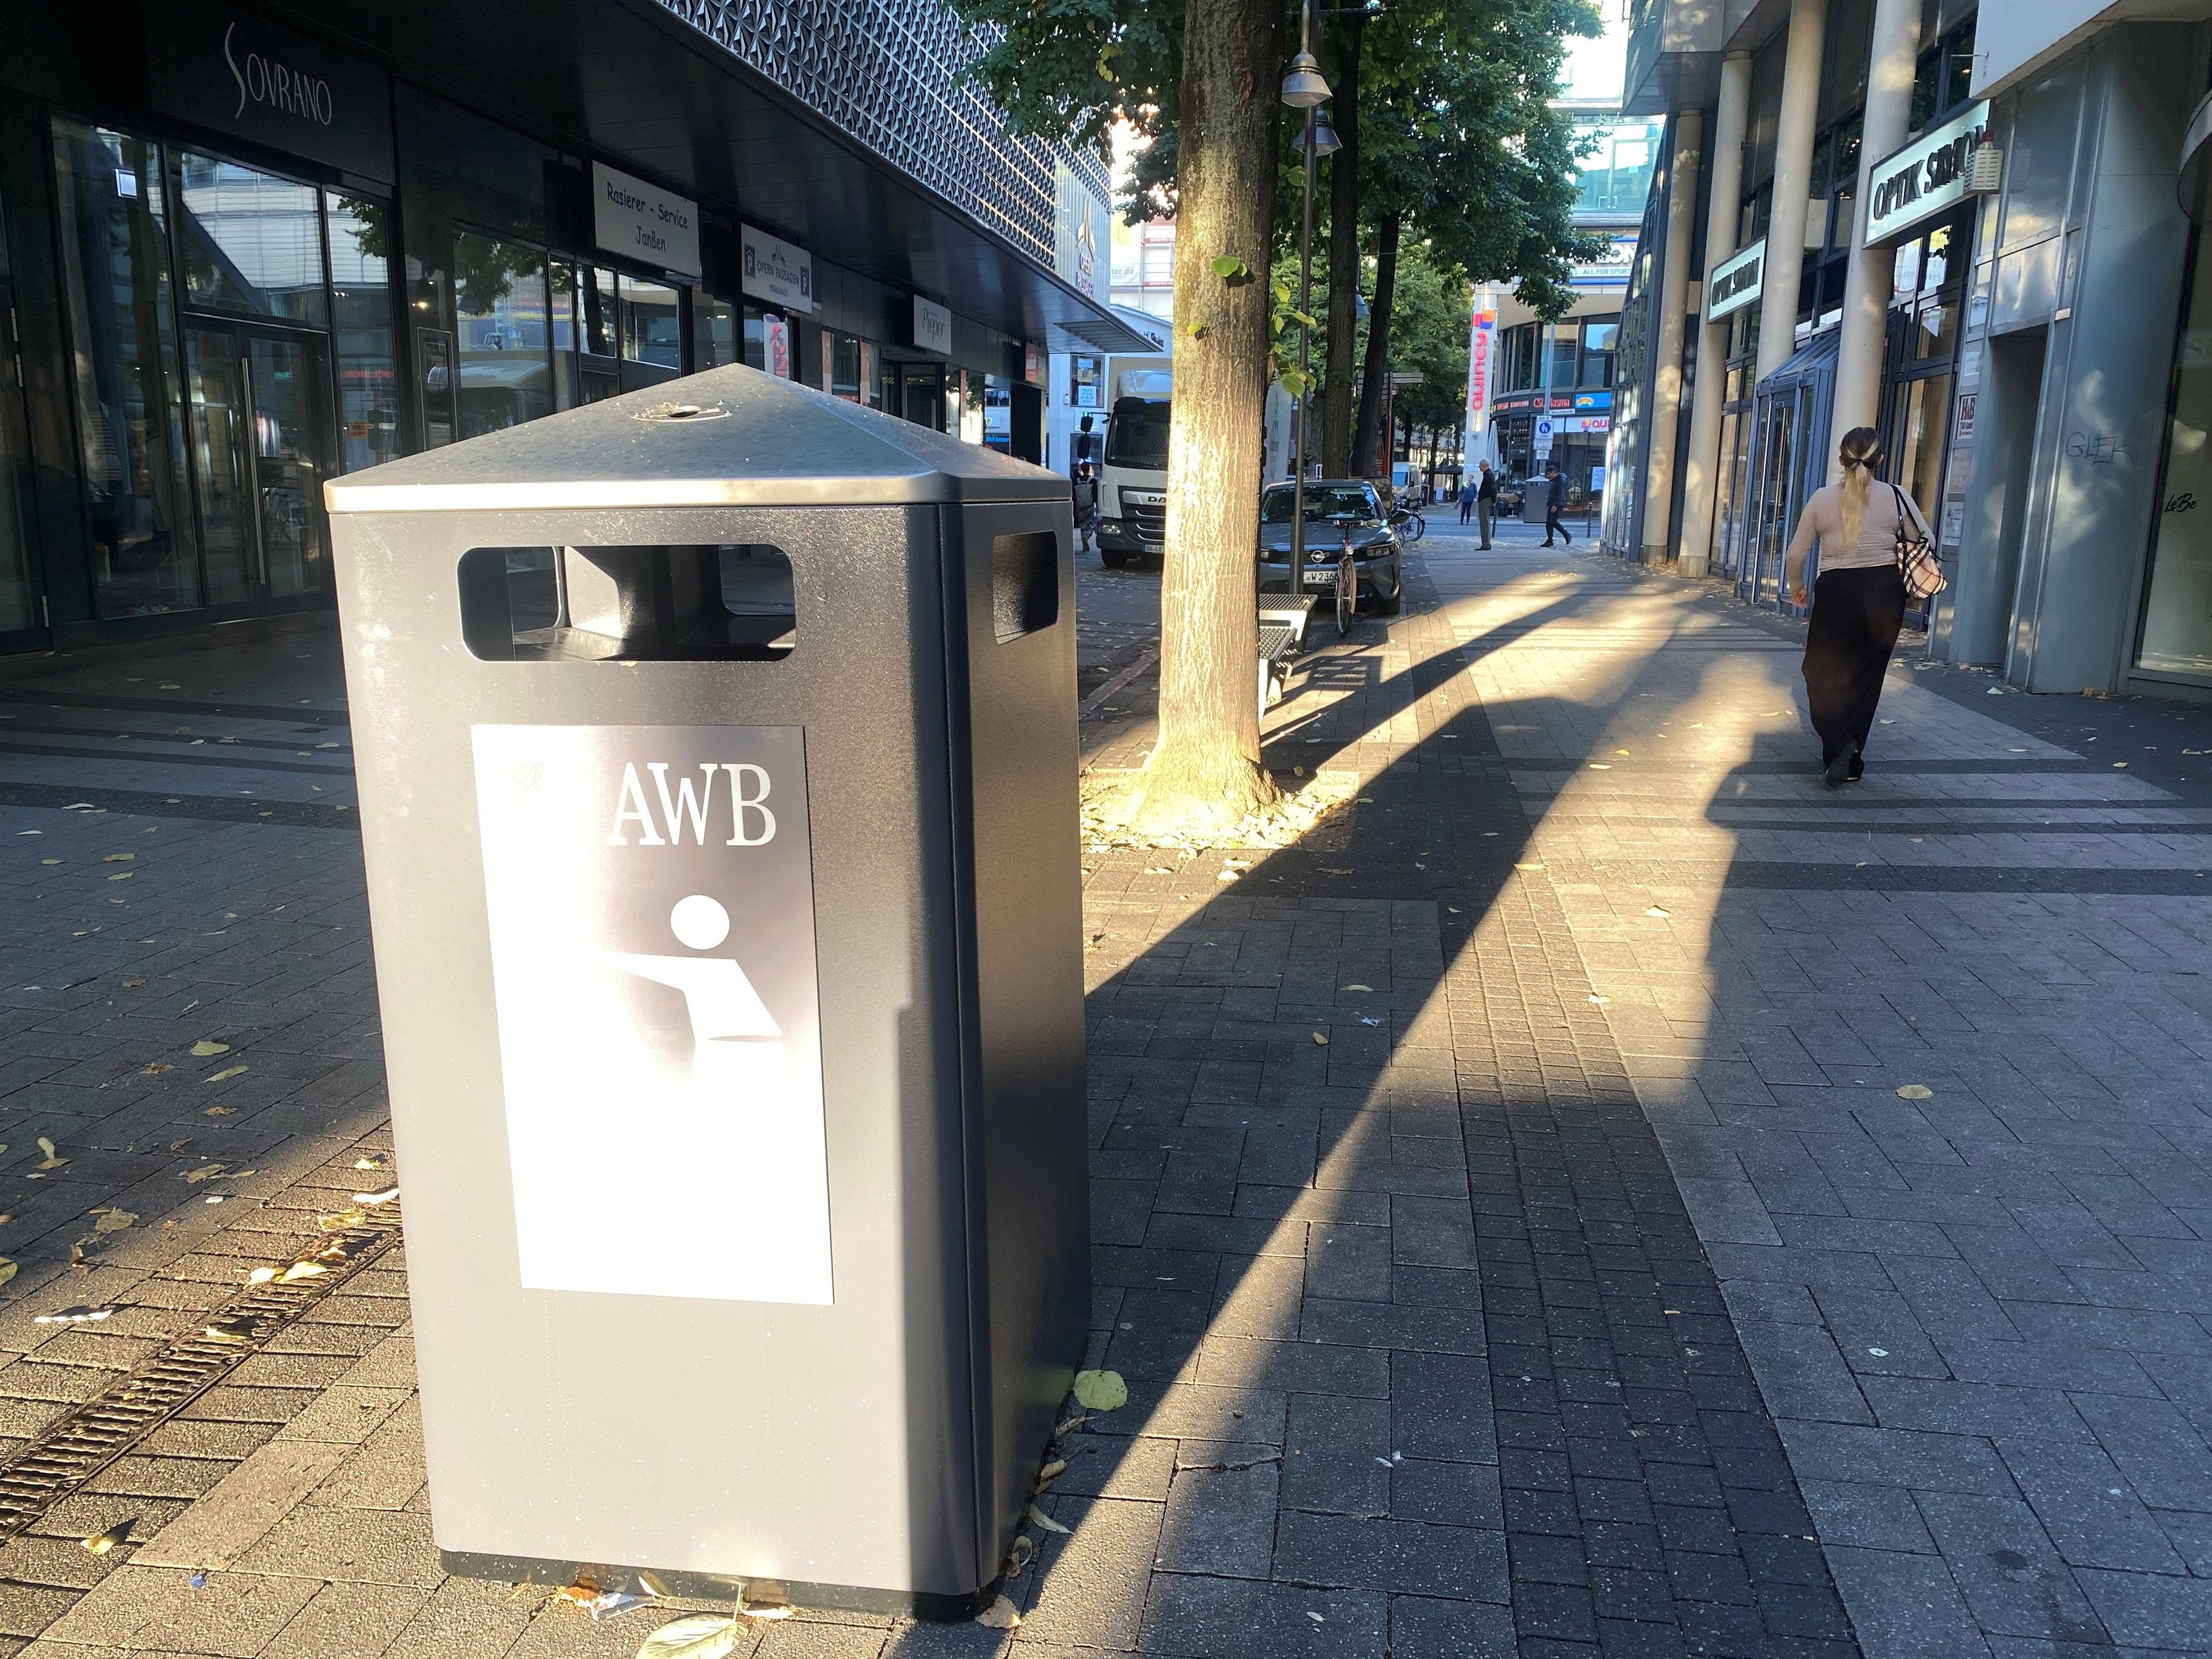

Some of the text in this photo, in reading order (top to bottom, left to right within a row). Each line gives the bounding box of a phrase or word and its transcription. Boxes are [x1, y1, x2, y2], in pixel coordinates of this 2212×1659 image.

[224, 22, 332, 126] SOVRANO
[1873, 159, 1926, 221] OPTIK
[607, 181, 645, 213] Rasierer
[658, 202, 688, 229] Service
[635, 225, 666, 253] Janßen
[757, 260, 800, 286] OPERN PASSAGEN
[769, 283, 789, 298] PARKHAUS
[922, 307, 945, 342] Pieper
[1551, 398, 1570, 408] lasma
[1592, 420, 1610, 428] QUI
[2164, 493, 2198, 513] LeBe
[1311, 572, 1317, 581] W
[606, 762, 778, 847] AWB
